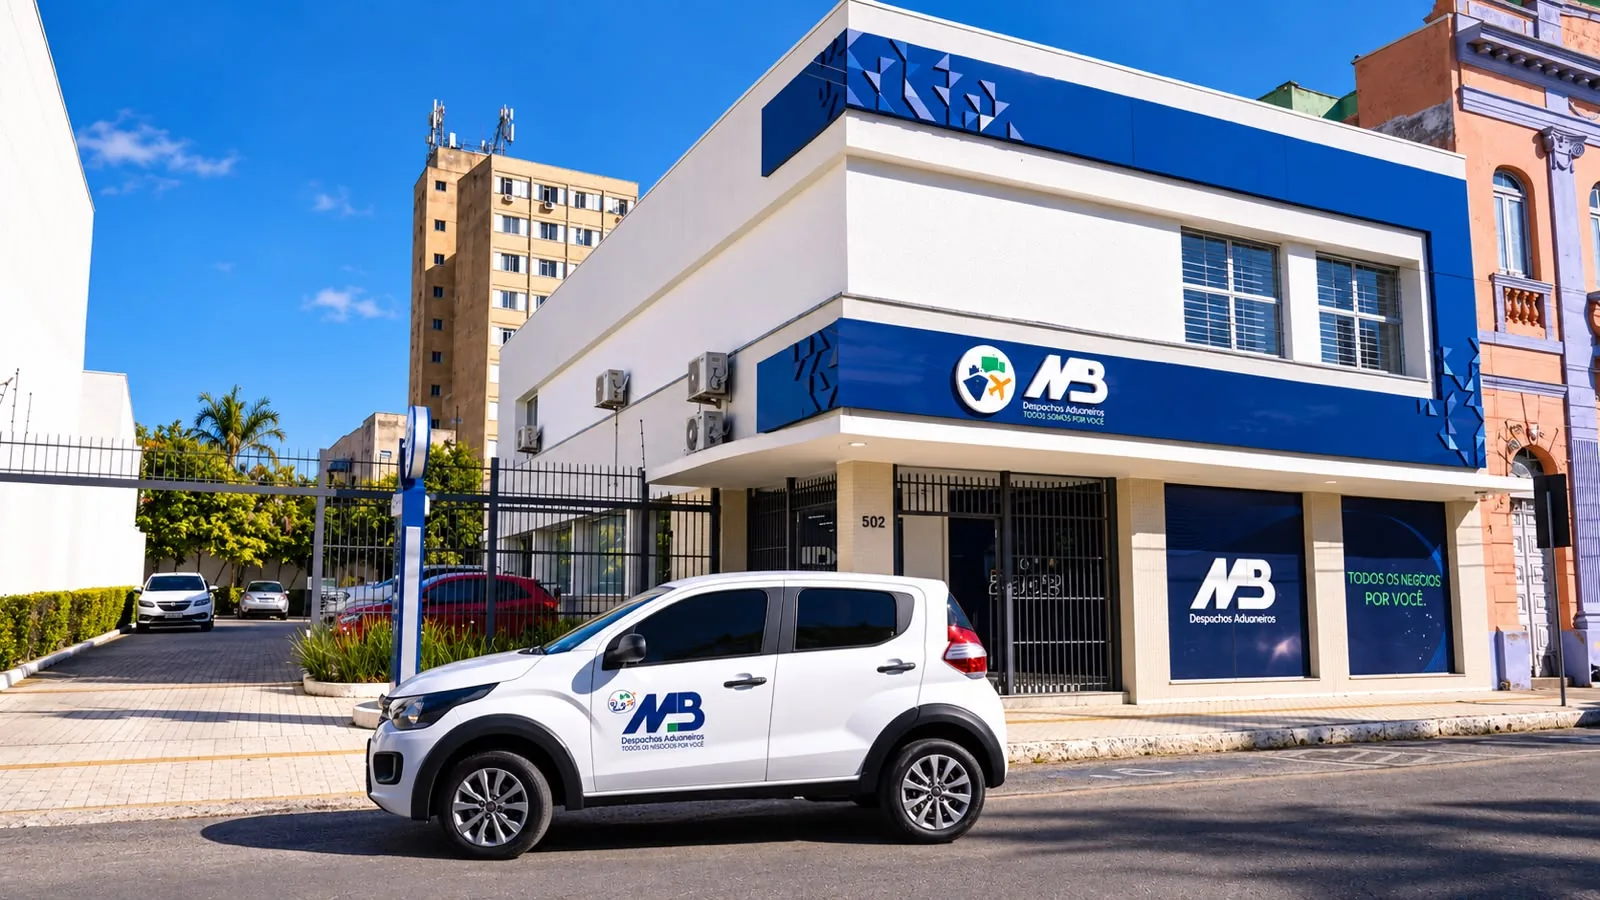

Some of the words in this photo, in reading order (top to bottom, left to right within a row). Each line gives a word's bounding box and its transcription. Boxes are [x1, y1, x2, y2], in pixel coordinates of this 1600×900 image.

[1023, 354, 1108, 404] MB
[1023, 401, 1063, 413] Despachos
[1065, 404, 1105, 417] Aduaneiros
[862, 515, 885, 528] 502
[1190, 557, 1276, 610] MB
[1347, 571, 1384, 585] TODOS
[1386, 573, 1399, 585] OS
[1365, 592, 1389, 606] POR
[1189, 613, 1232, 625] Despachos
[1233, 613, 1276, 624] Aduaneiros
[622, 691, 705, 735] MB
[621, 735, 662, 746] Despachos
[664, 733, 704, 743] Aduaneiros
